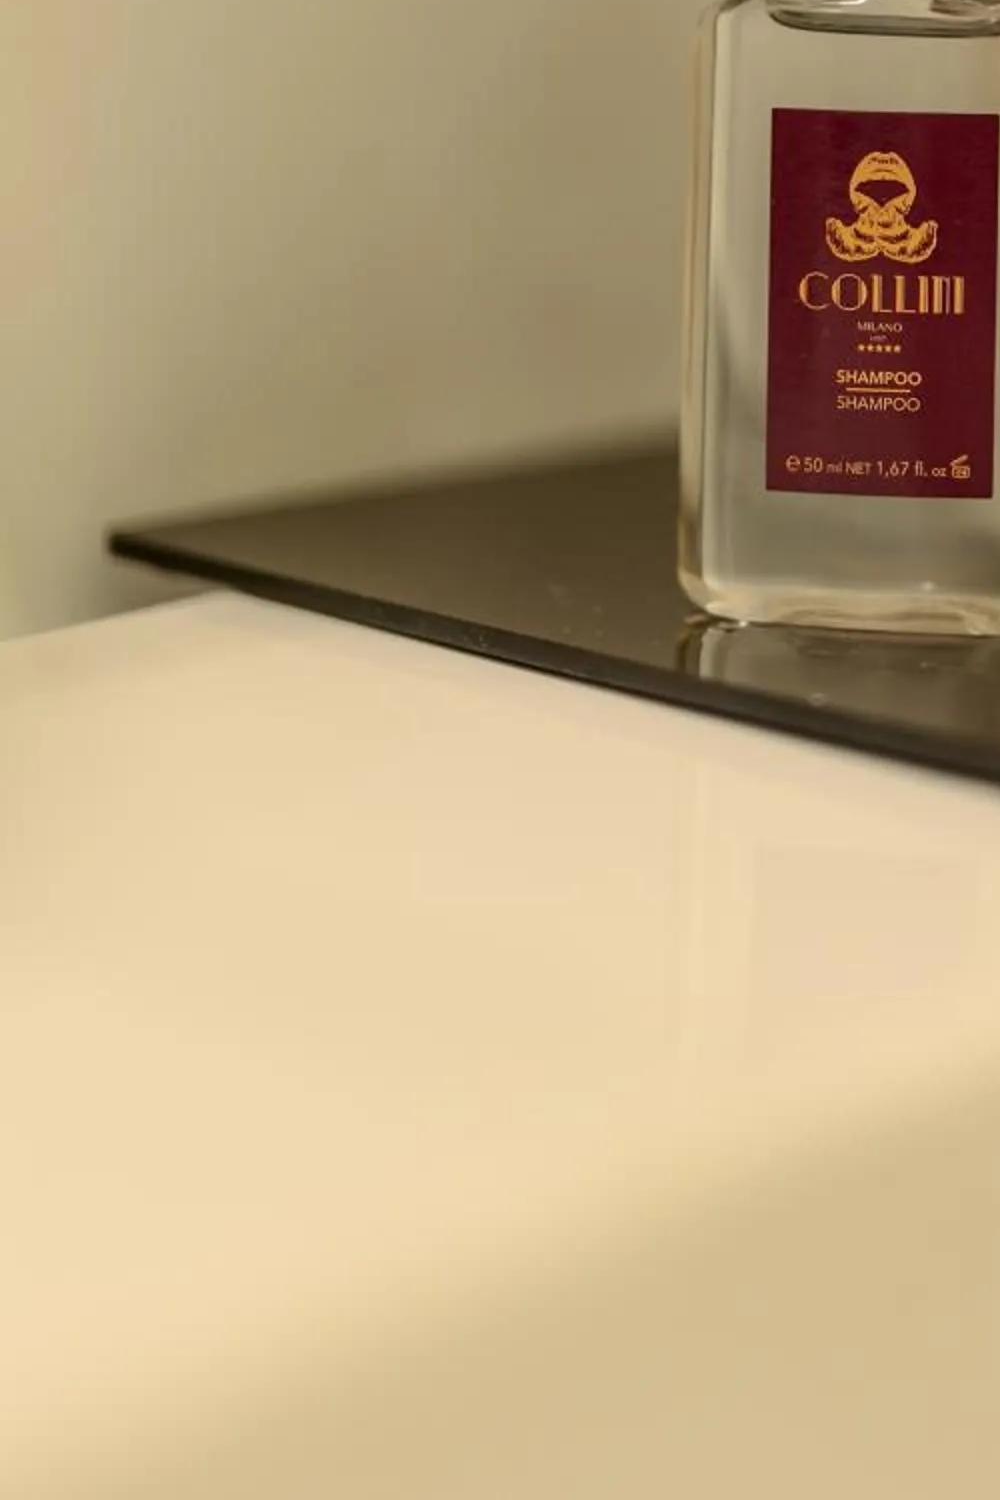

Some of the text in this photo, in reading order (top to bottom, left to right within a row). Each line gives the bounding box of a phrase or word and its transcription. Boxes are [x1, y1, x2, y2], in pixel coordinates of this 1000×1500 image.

[799, 271, 965, 315] COLLINI
[857, 321, 903, 333] MILANO
[835, 369, 922, 386] SHAMPOO
[836, 396, 921, 412] SHAMPOO
[803, 457, 823, 473] 50
[845, 461, 872, 476] NET
[876, 461, 909, 478] 1,67
[931, 467, 947, 478] oz
